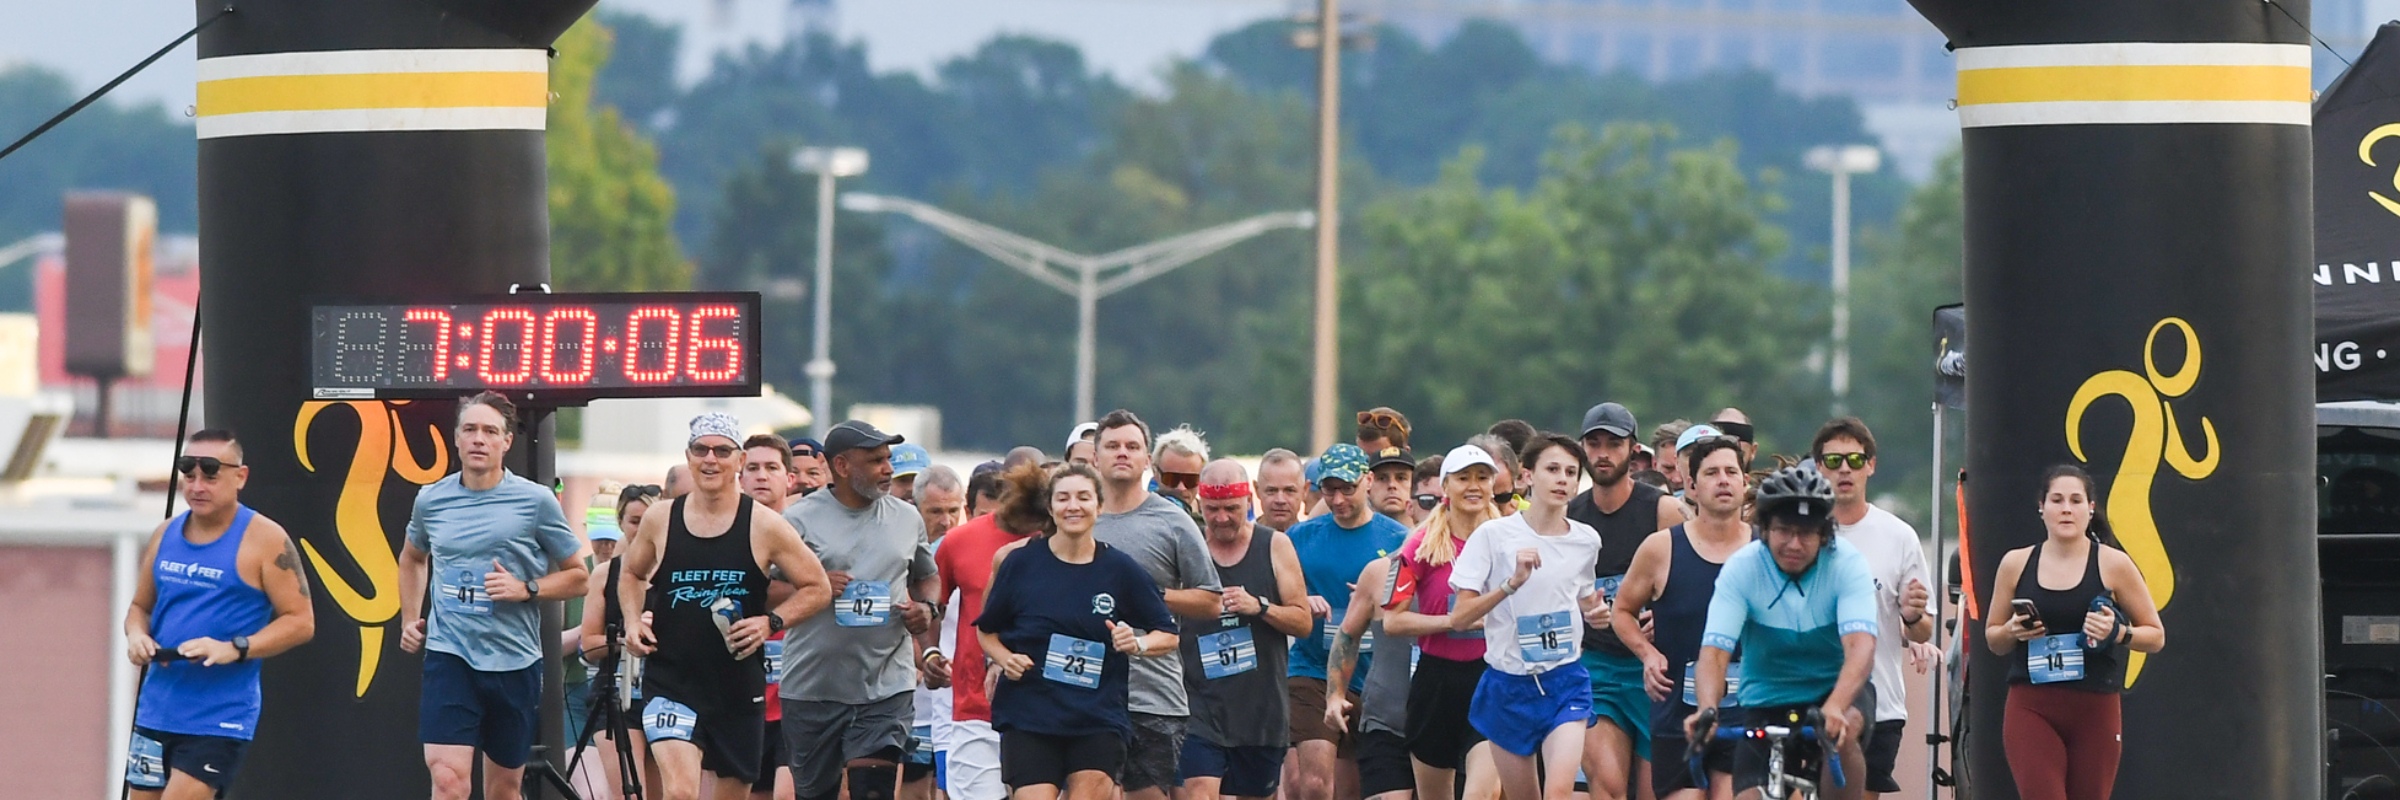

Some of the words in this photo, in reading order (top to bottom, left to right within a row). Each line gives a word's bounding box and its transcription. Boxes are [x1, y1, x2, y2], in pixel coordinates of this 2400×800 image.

[160, 560, 187, 574] FLEET
[198, 566, 224, 580] FEET
[671, 570, 710, 583] FLEET
[712, 570, 746, 581] FEET
[457, 586, 475, 604] 41
[667, 585, 719, 608] Racing
[714, 581, 750, 600] Team
[852, 598, 873, 616] 42
[1538, 630, 1558, 650] 18
[1062, 655, 1086, 675] 23
[1218, 647, 1238, 666] 57
[2045, 652, 2065, 671] 14
[656, 712, 678, 729] 60
[133, 754, 150, 775] 25
